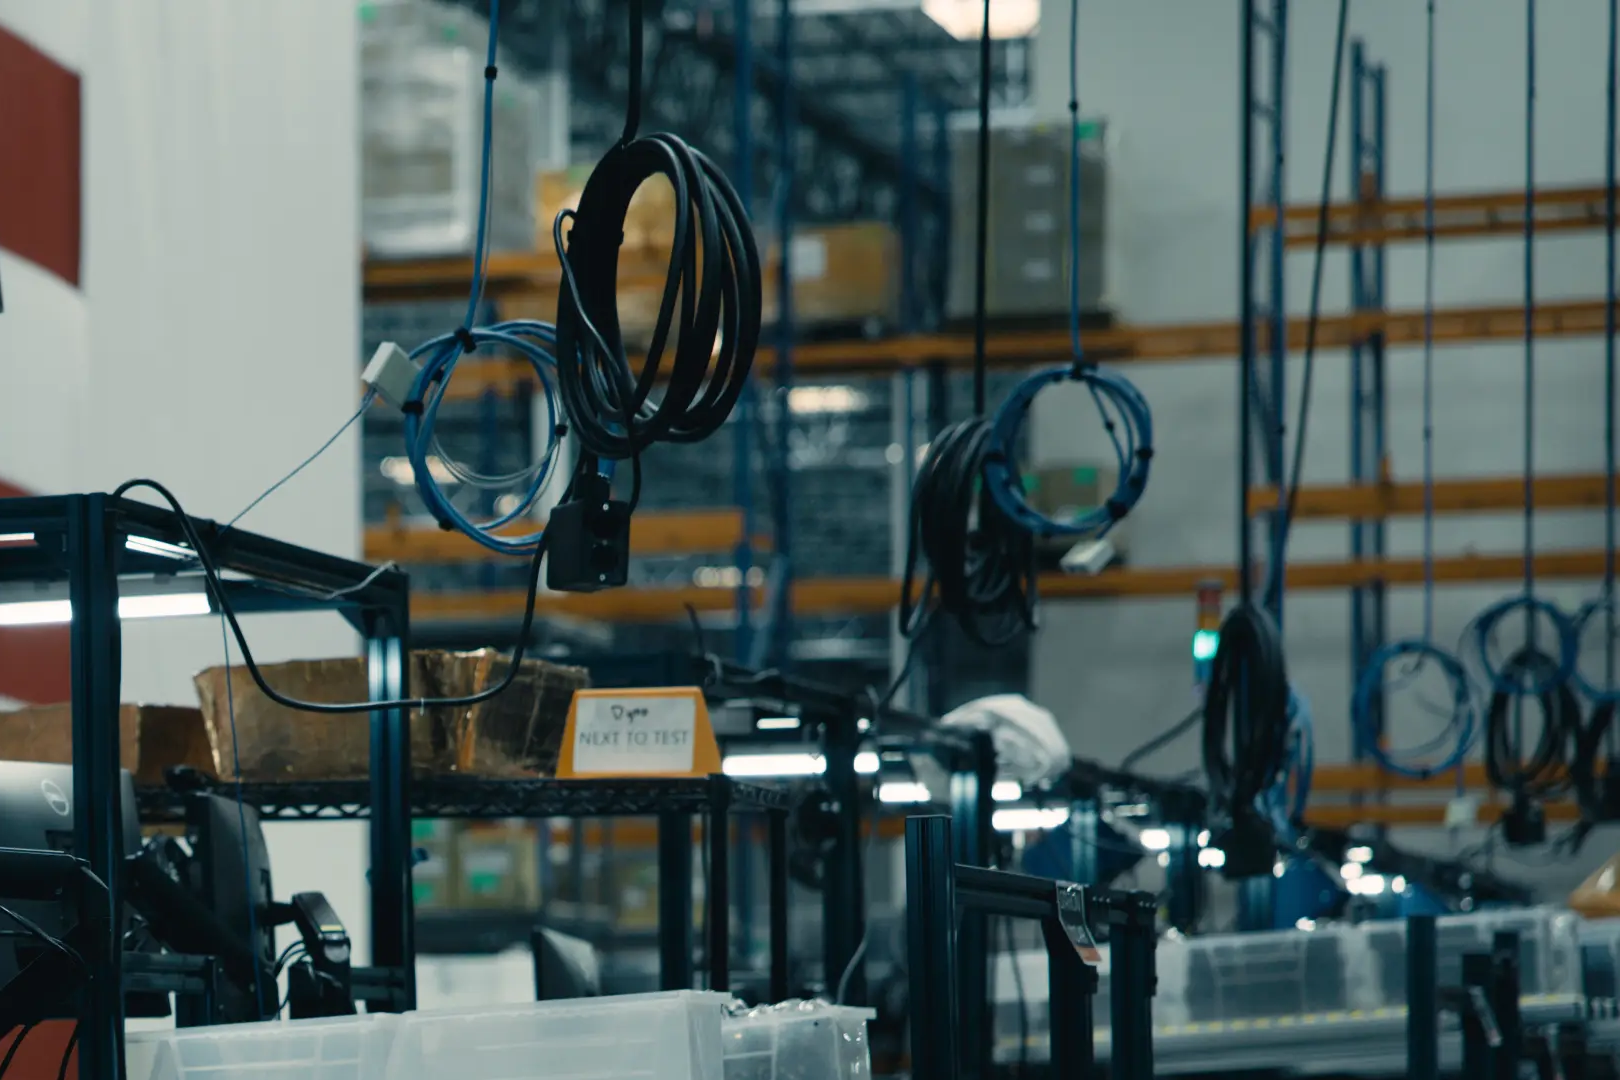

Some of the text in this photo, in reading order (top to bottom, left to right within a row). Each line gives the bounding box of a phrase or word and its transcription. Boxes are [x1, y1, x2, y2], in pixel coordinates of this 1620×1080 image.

[579, 730, 688, 746] NEXT TO TEST
